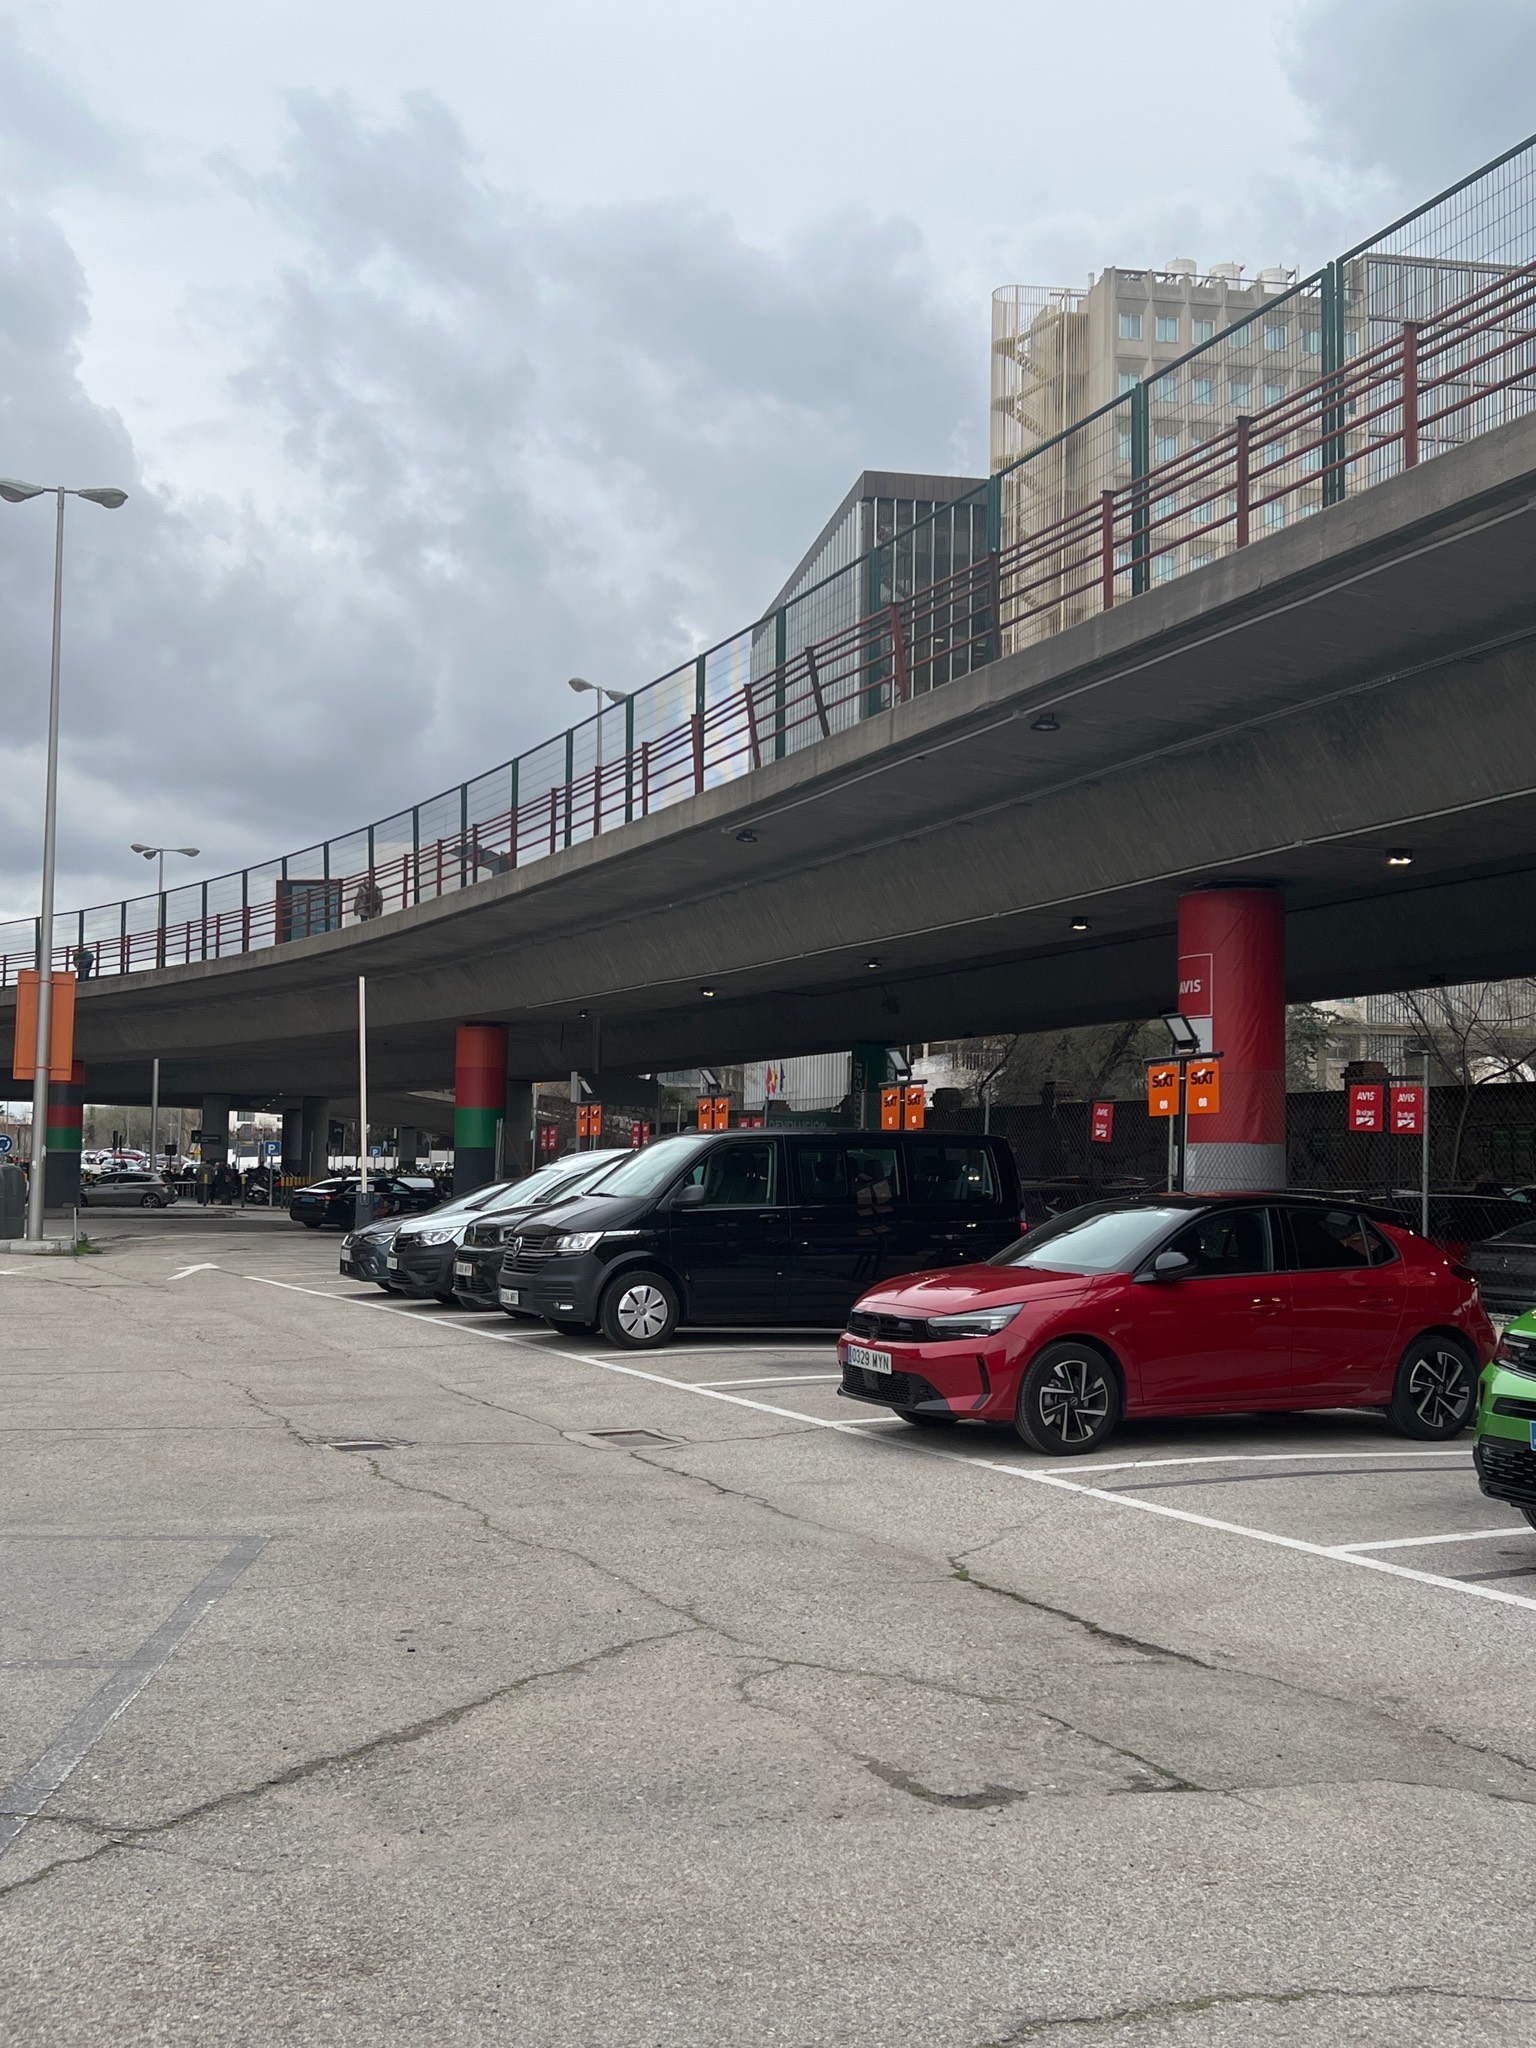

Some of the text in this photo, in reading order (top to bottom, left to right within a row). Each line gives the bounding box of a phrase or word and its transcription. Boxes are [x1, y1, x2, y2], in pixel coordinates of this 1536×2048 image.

[1179, 979, 1202, 995] AVIS
[1357, 1092, 1375, 1101] AVIS
[1397, 1093, 1416, 1103] AVIS
[852, 1347, 889, 1371] 0329 MYN
